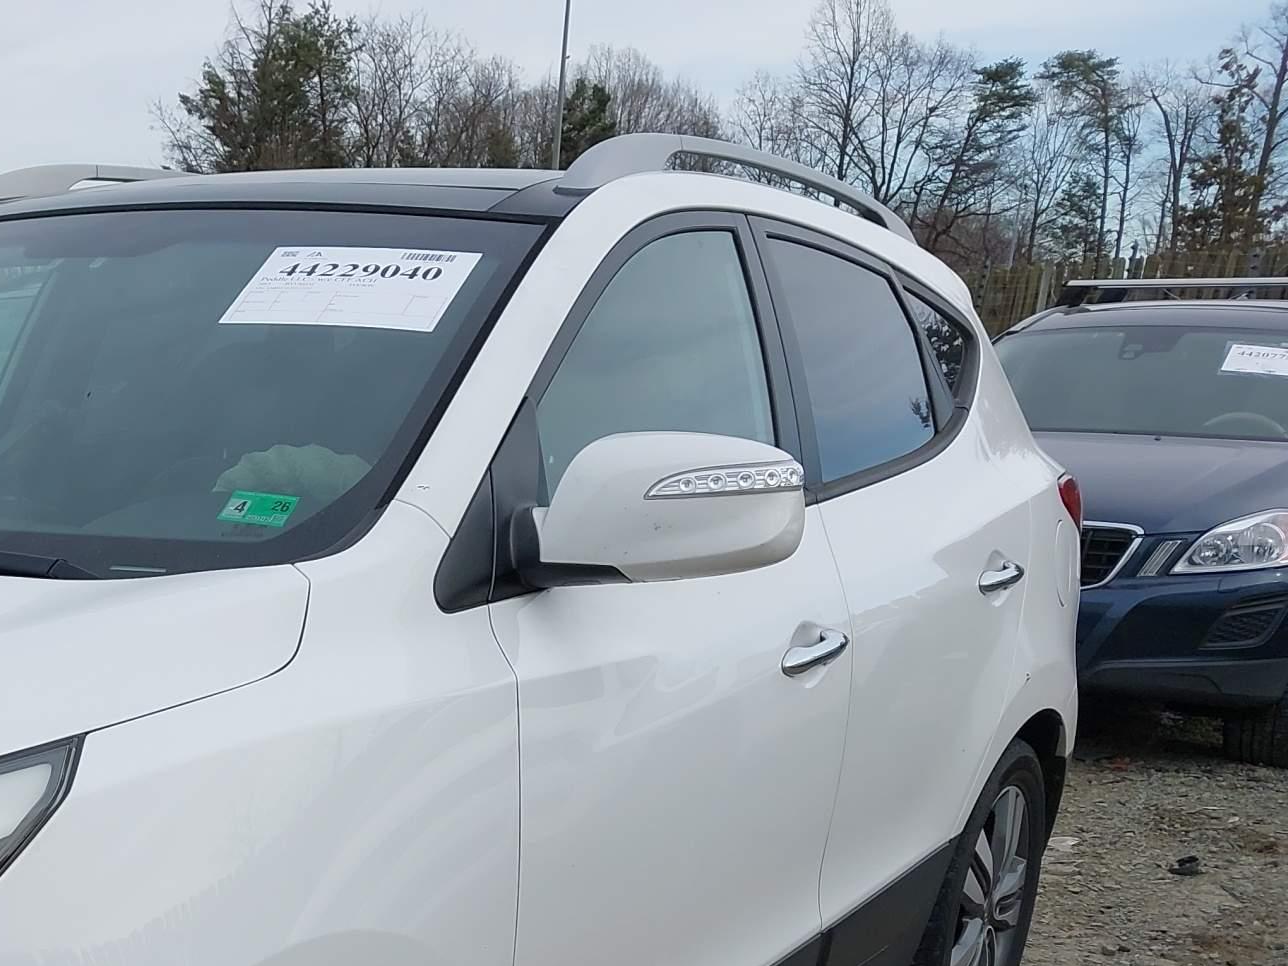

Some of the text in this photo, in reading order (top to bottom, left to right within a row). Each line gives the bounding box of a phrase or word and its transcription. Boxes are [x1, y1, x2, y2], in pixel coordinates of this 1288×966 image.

[279, 262, 443, 281] 44229040
[233, 500, 248, 513] 4
[272, 500, 291, 513] 26
